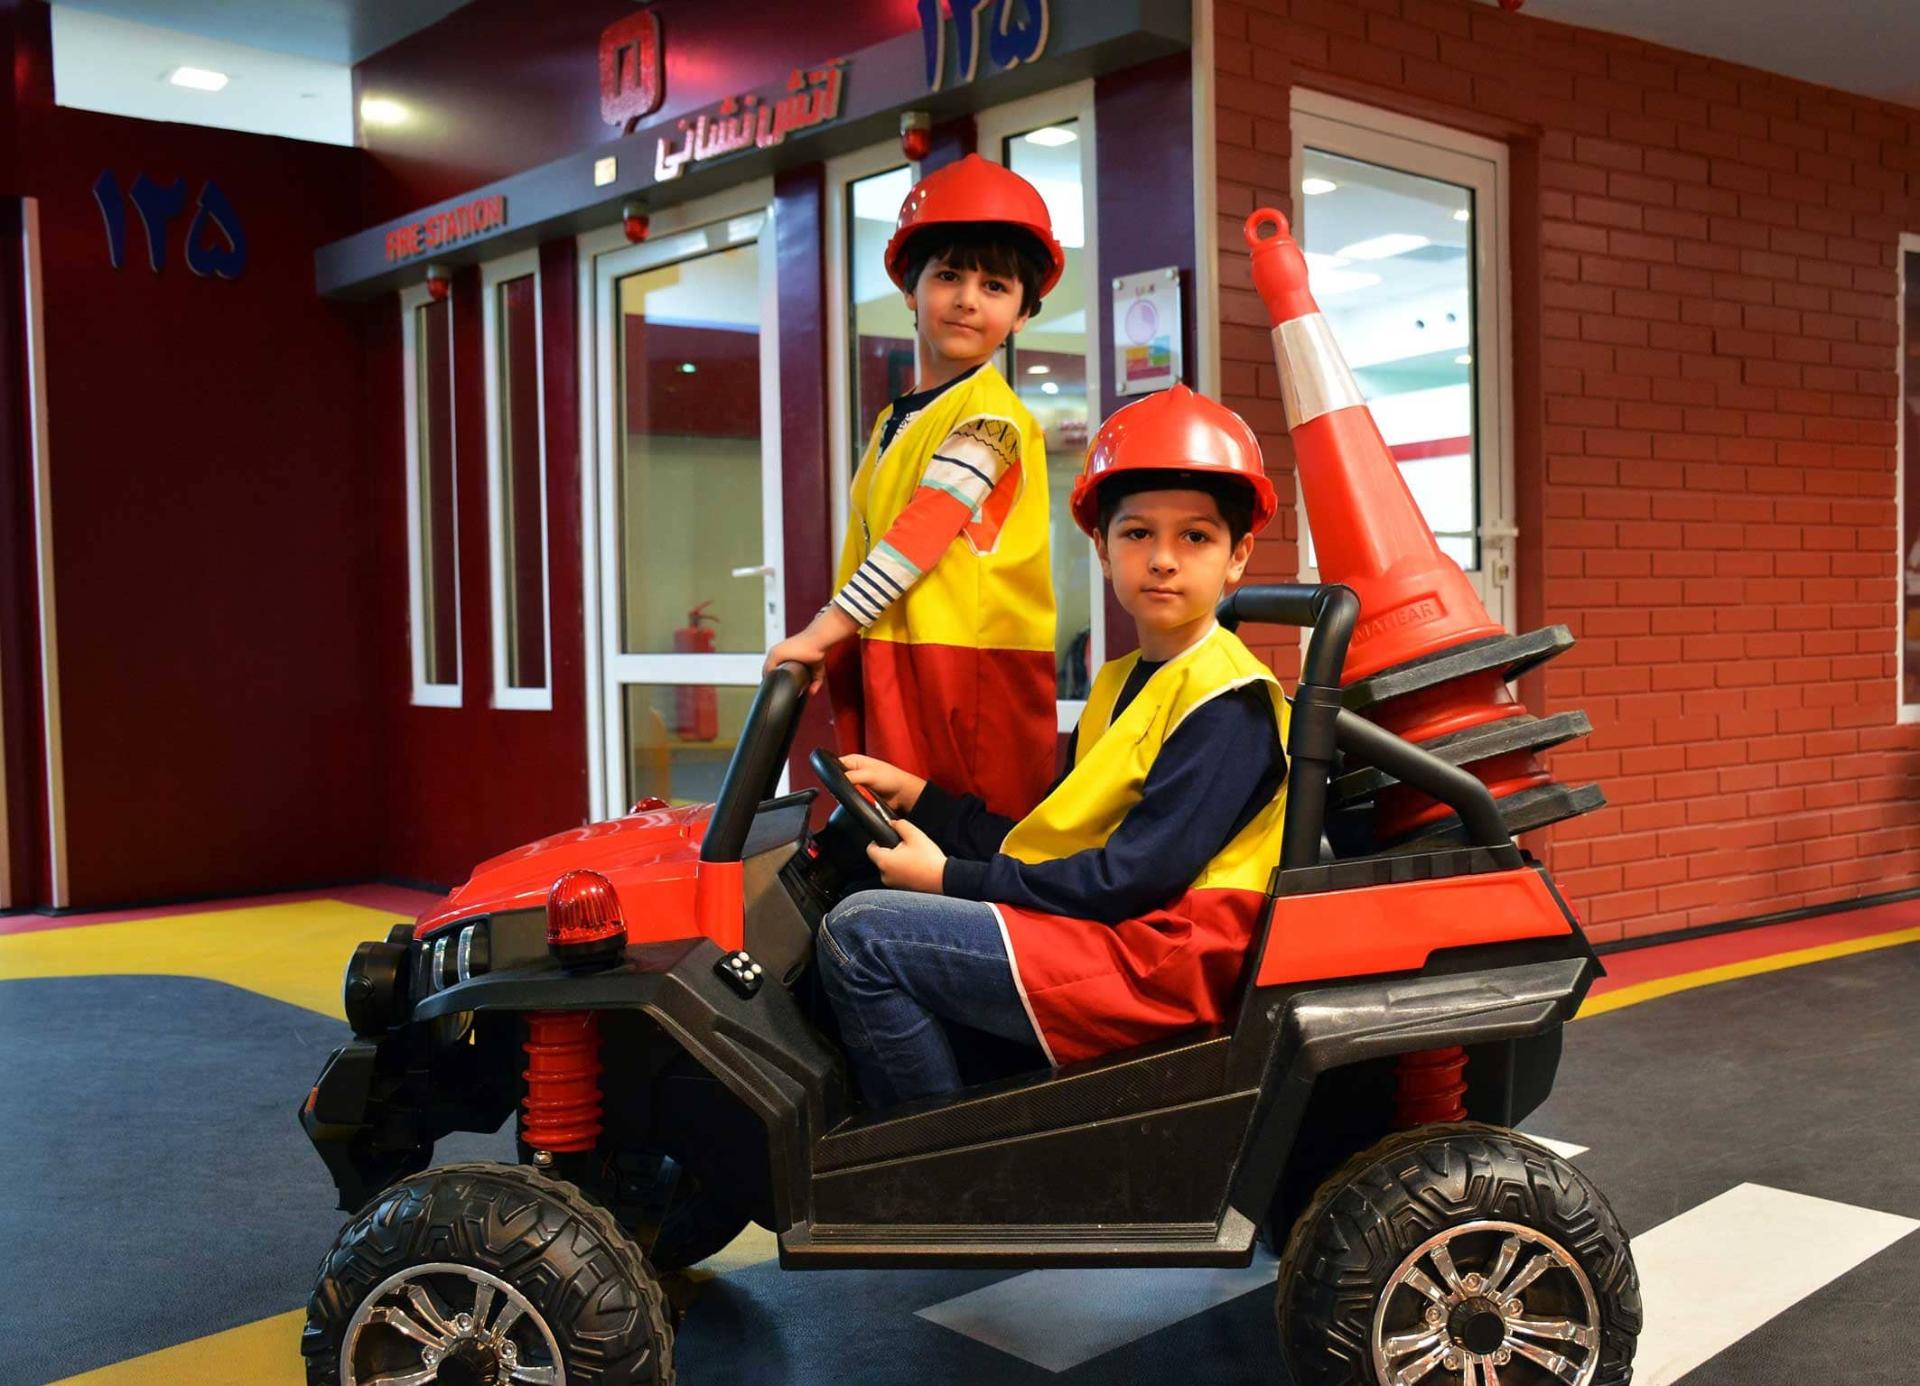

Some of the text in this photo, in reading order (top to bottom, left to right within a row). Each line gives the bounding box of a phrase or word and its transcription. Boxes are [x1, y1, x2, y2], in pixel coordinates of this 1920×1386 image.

[93, 168, 247, 279] ۱۲۵
[385, 193, 507, 262] FIRE STATION
